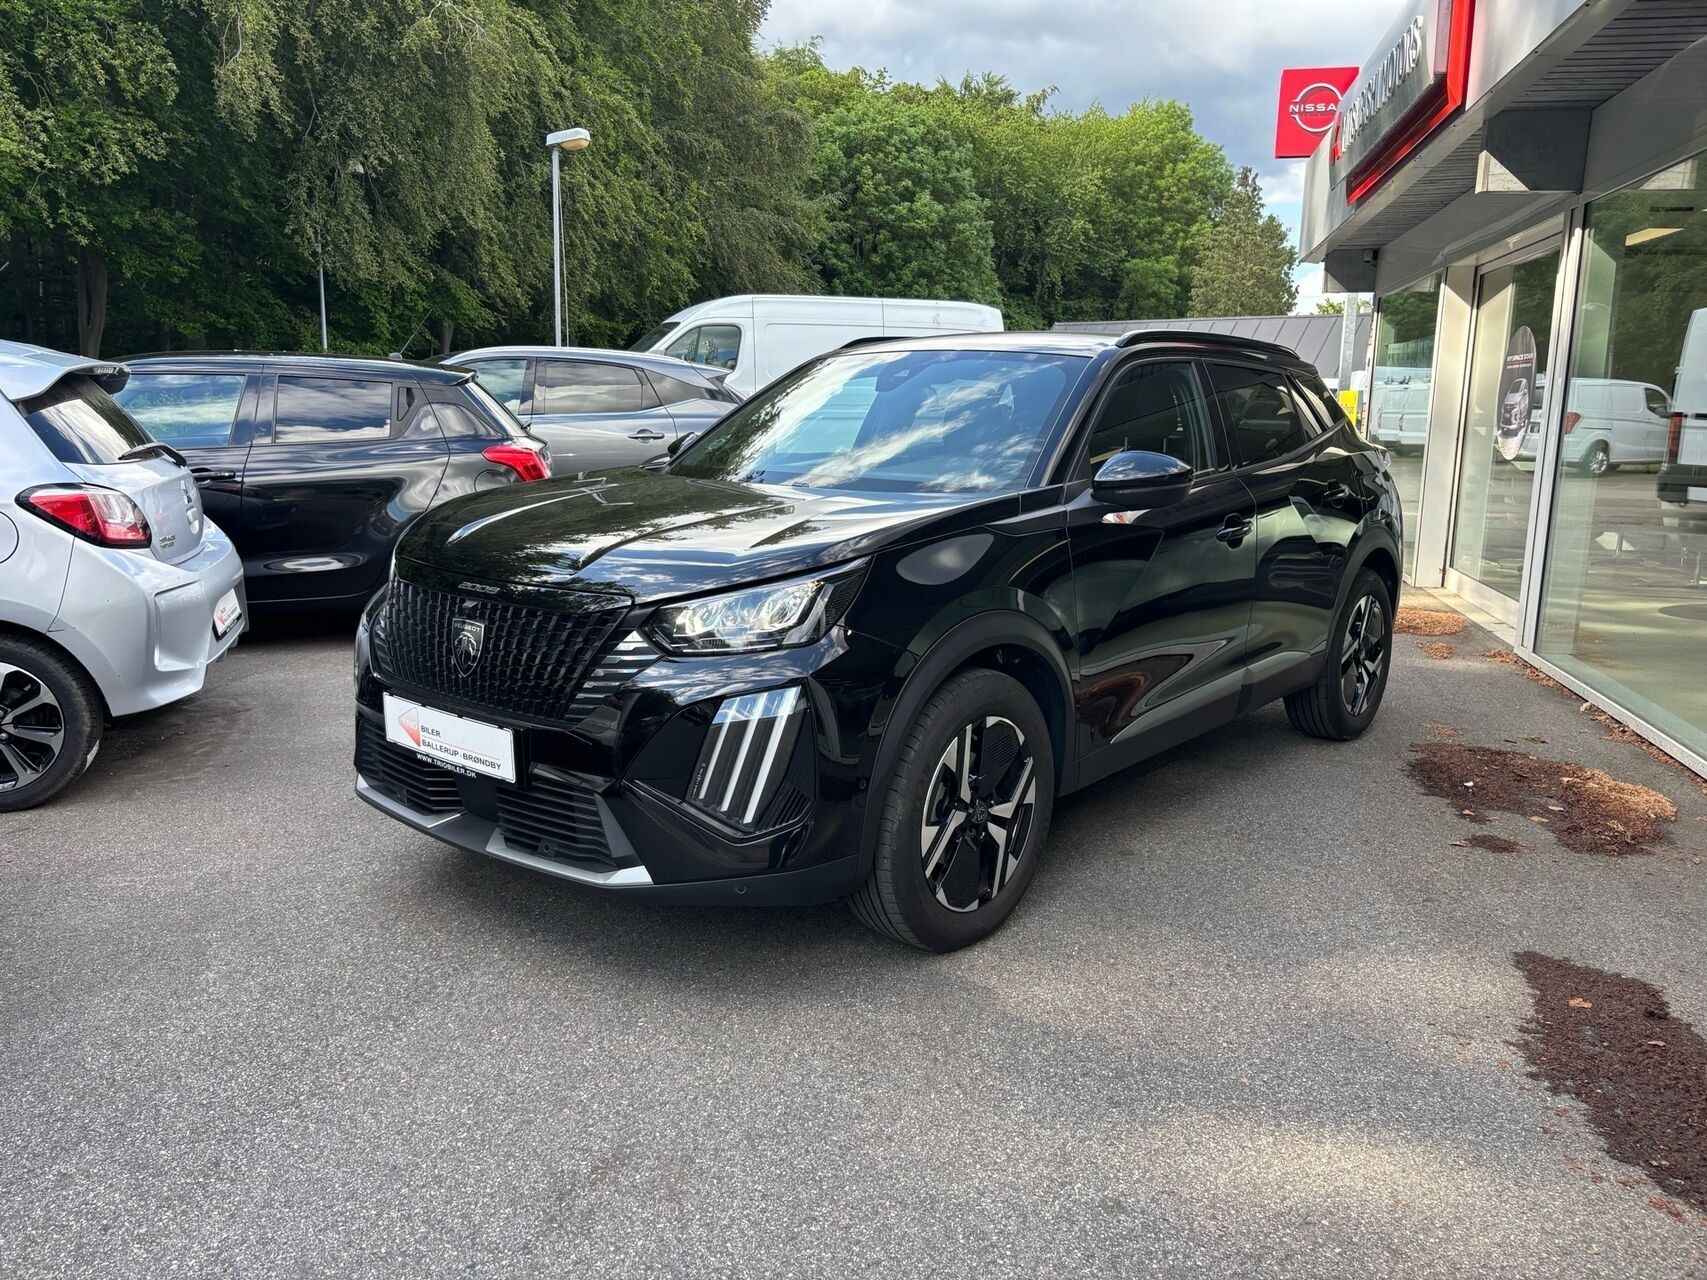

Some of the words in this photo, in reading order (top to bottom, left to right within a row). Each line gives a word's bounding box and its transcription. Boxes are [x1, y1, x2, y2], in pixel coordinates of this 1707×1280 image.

[1289, 103, 1337, 113] NISSA
[458, 581, 500, 594] 2008
[454, 622, 481, 633] PEUGEOT
[420, 725, 441, 738] BILER
[422, 739, 459, 758] BALLERUP
[462, 752, 502, 770] BRØNDBY
